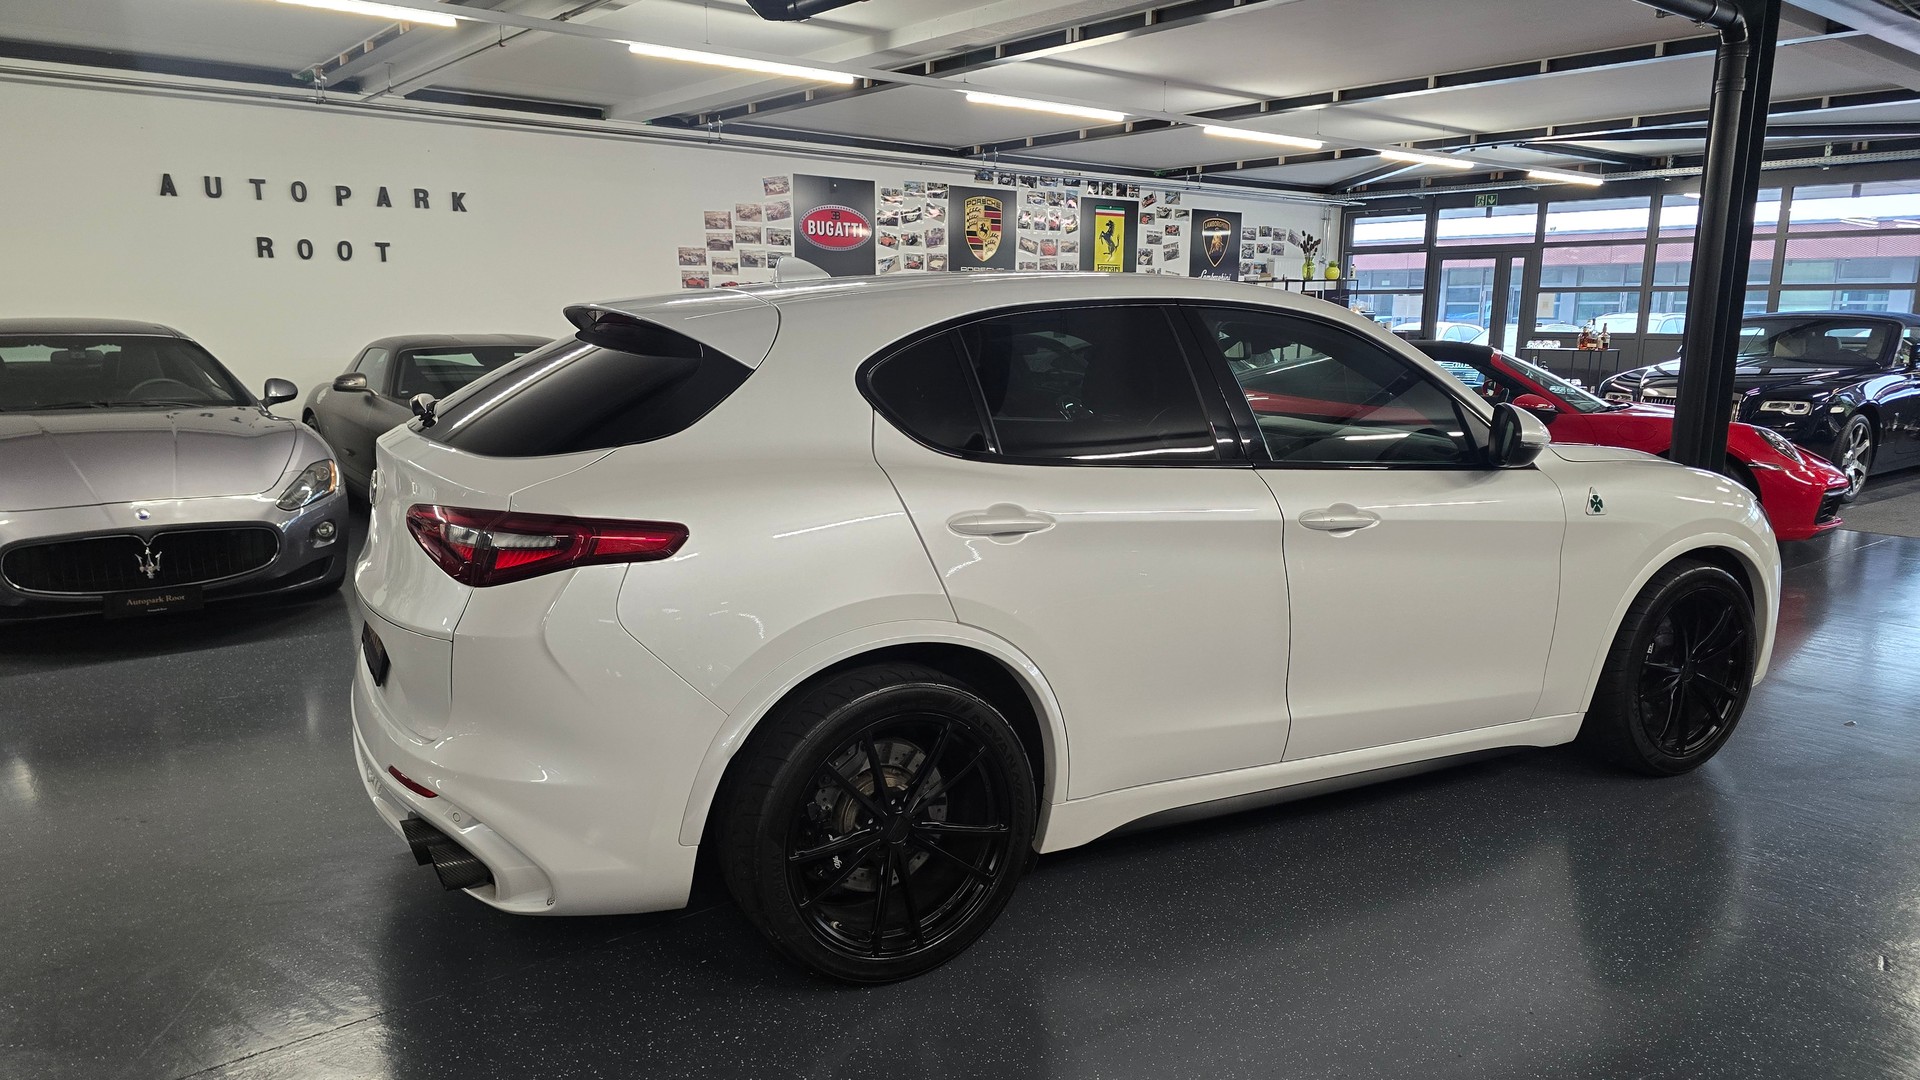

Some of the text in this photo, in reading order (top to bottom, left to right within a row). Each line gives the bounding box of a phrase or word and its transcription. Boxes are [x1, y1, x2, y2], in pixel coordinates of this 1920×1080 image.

[160, 173, 467, 212] AUTOPARK
[807, 219, 863, 238] BUGATTI
[256, 236, 390, 262] ROOT
[126, 594, 186, 606] Autopark Root
